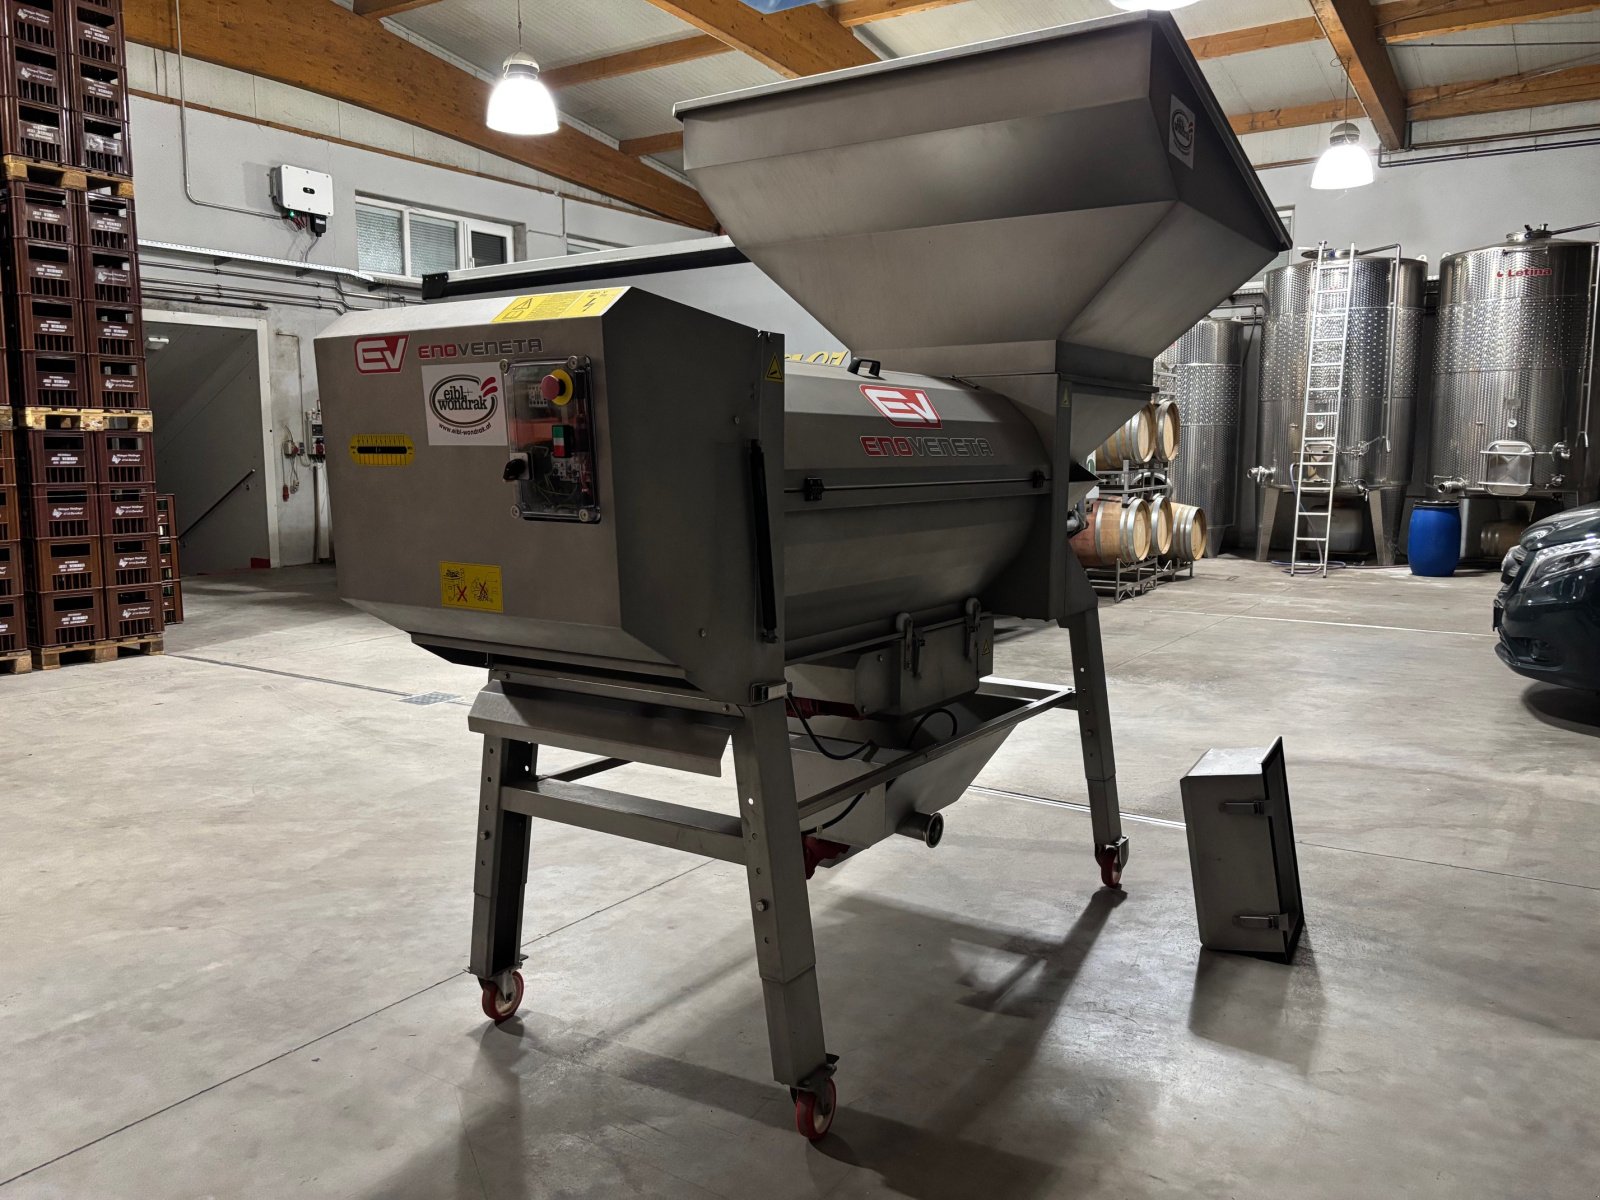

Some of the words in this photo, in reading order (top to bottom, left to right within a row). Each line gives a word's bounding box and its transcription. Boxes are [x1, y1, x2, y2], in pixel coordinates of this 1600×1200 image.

[1507, 267, 1553, 278] Letina
[356, 336, 408, 371] EV
[418, 338, 545, 360] ENOVENETA
[437, 395, 488, 411] wondrak
[862, 386, 940, 425] EV
[859, 435, 995, 457] ENOVENETA
